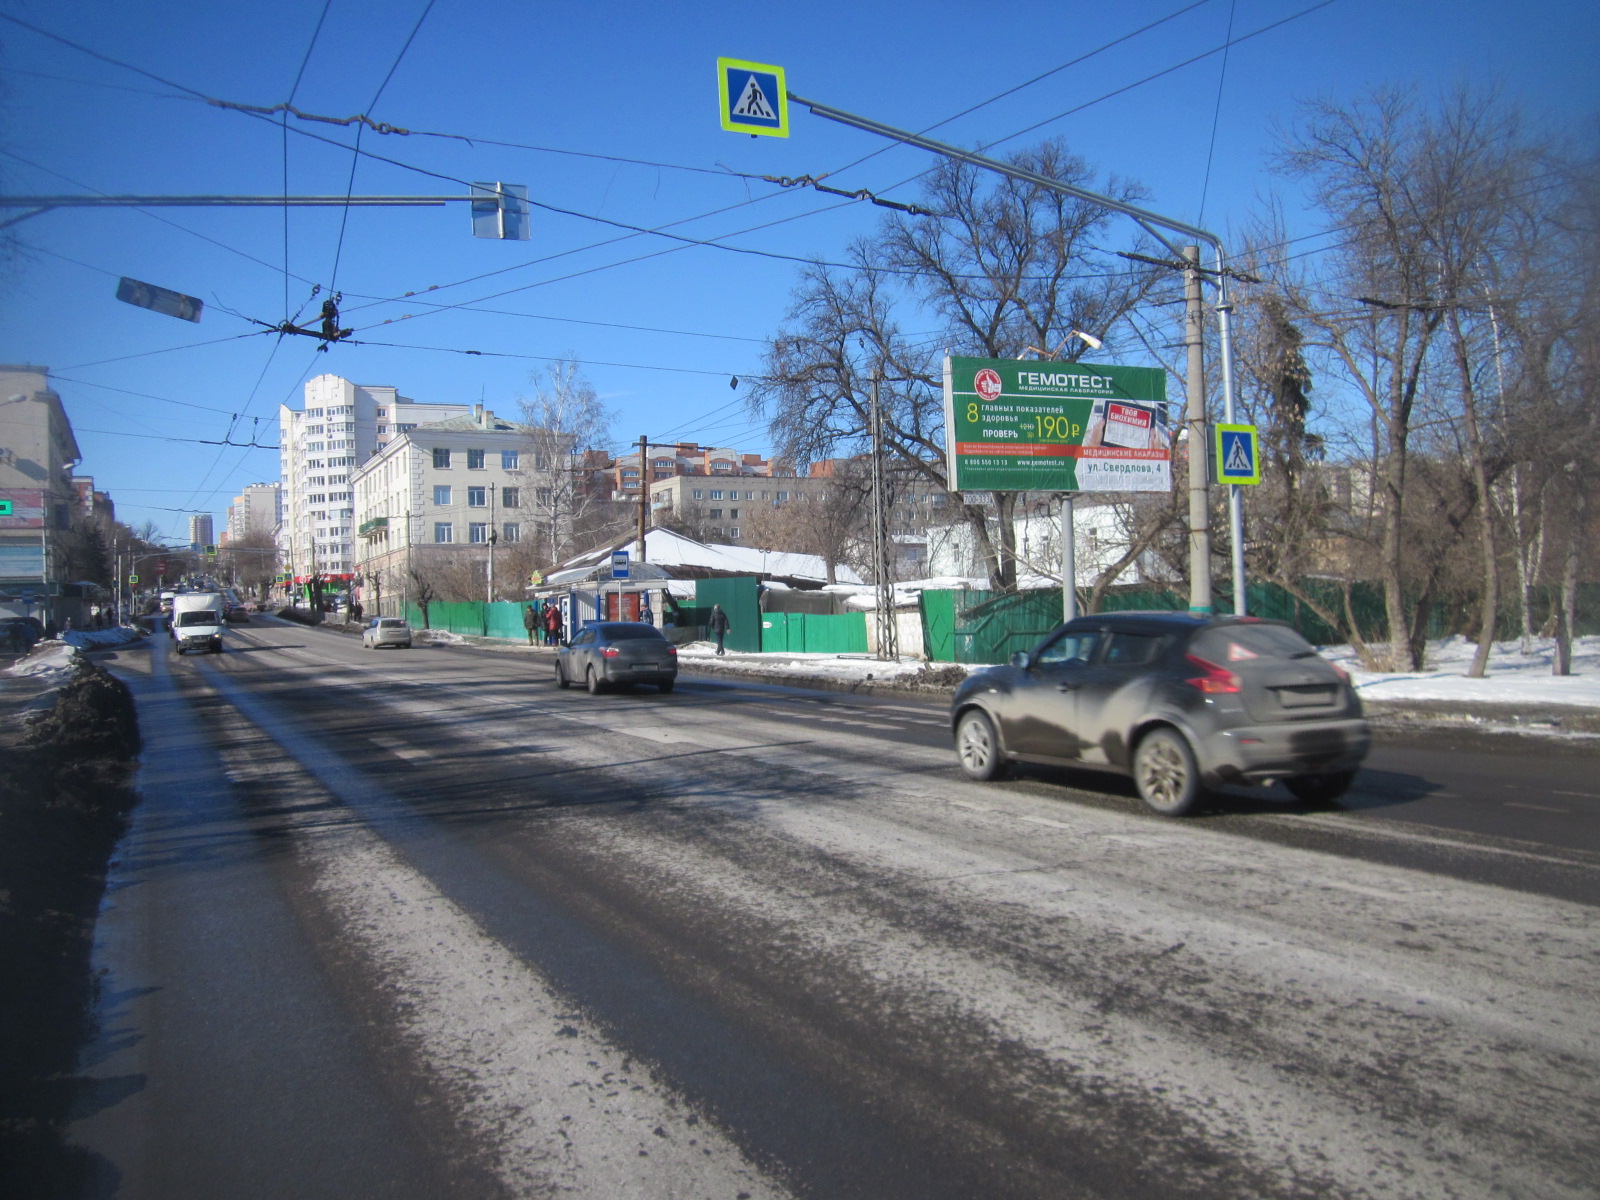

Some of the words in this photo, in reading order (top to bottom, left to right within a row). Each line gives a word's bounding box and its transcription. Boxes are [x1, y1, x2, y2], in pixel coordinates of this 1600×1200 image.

[1018, 371, 1113, 389] ГЕМОТЕСТ
[967, 403, 979, 423] 8
[981, 404, 1014, 412] главных
[1016, 405, 1064, 414] показателей
[1121, 407, 1138, 417] ТВОЯ
[981, 414, 1019, 423] здоровья
[1110, 412, 1147, 427] БИОХИМИЯ
[1035, 415, 1069, 439] 190
[982, 429, 1019, 438] ПРОВЕРЬ
[1083, 448, 1132, 458] МЕДИЦИНСКИЕ
[1017, 459, 1065, 467] www.gemotest.ru
[1088, 463, 1101, 473] ул.
[1103, 462, 1154, 474] Свердлова,
[1156, 463, 1161, 472] 4
